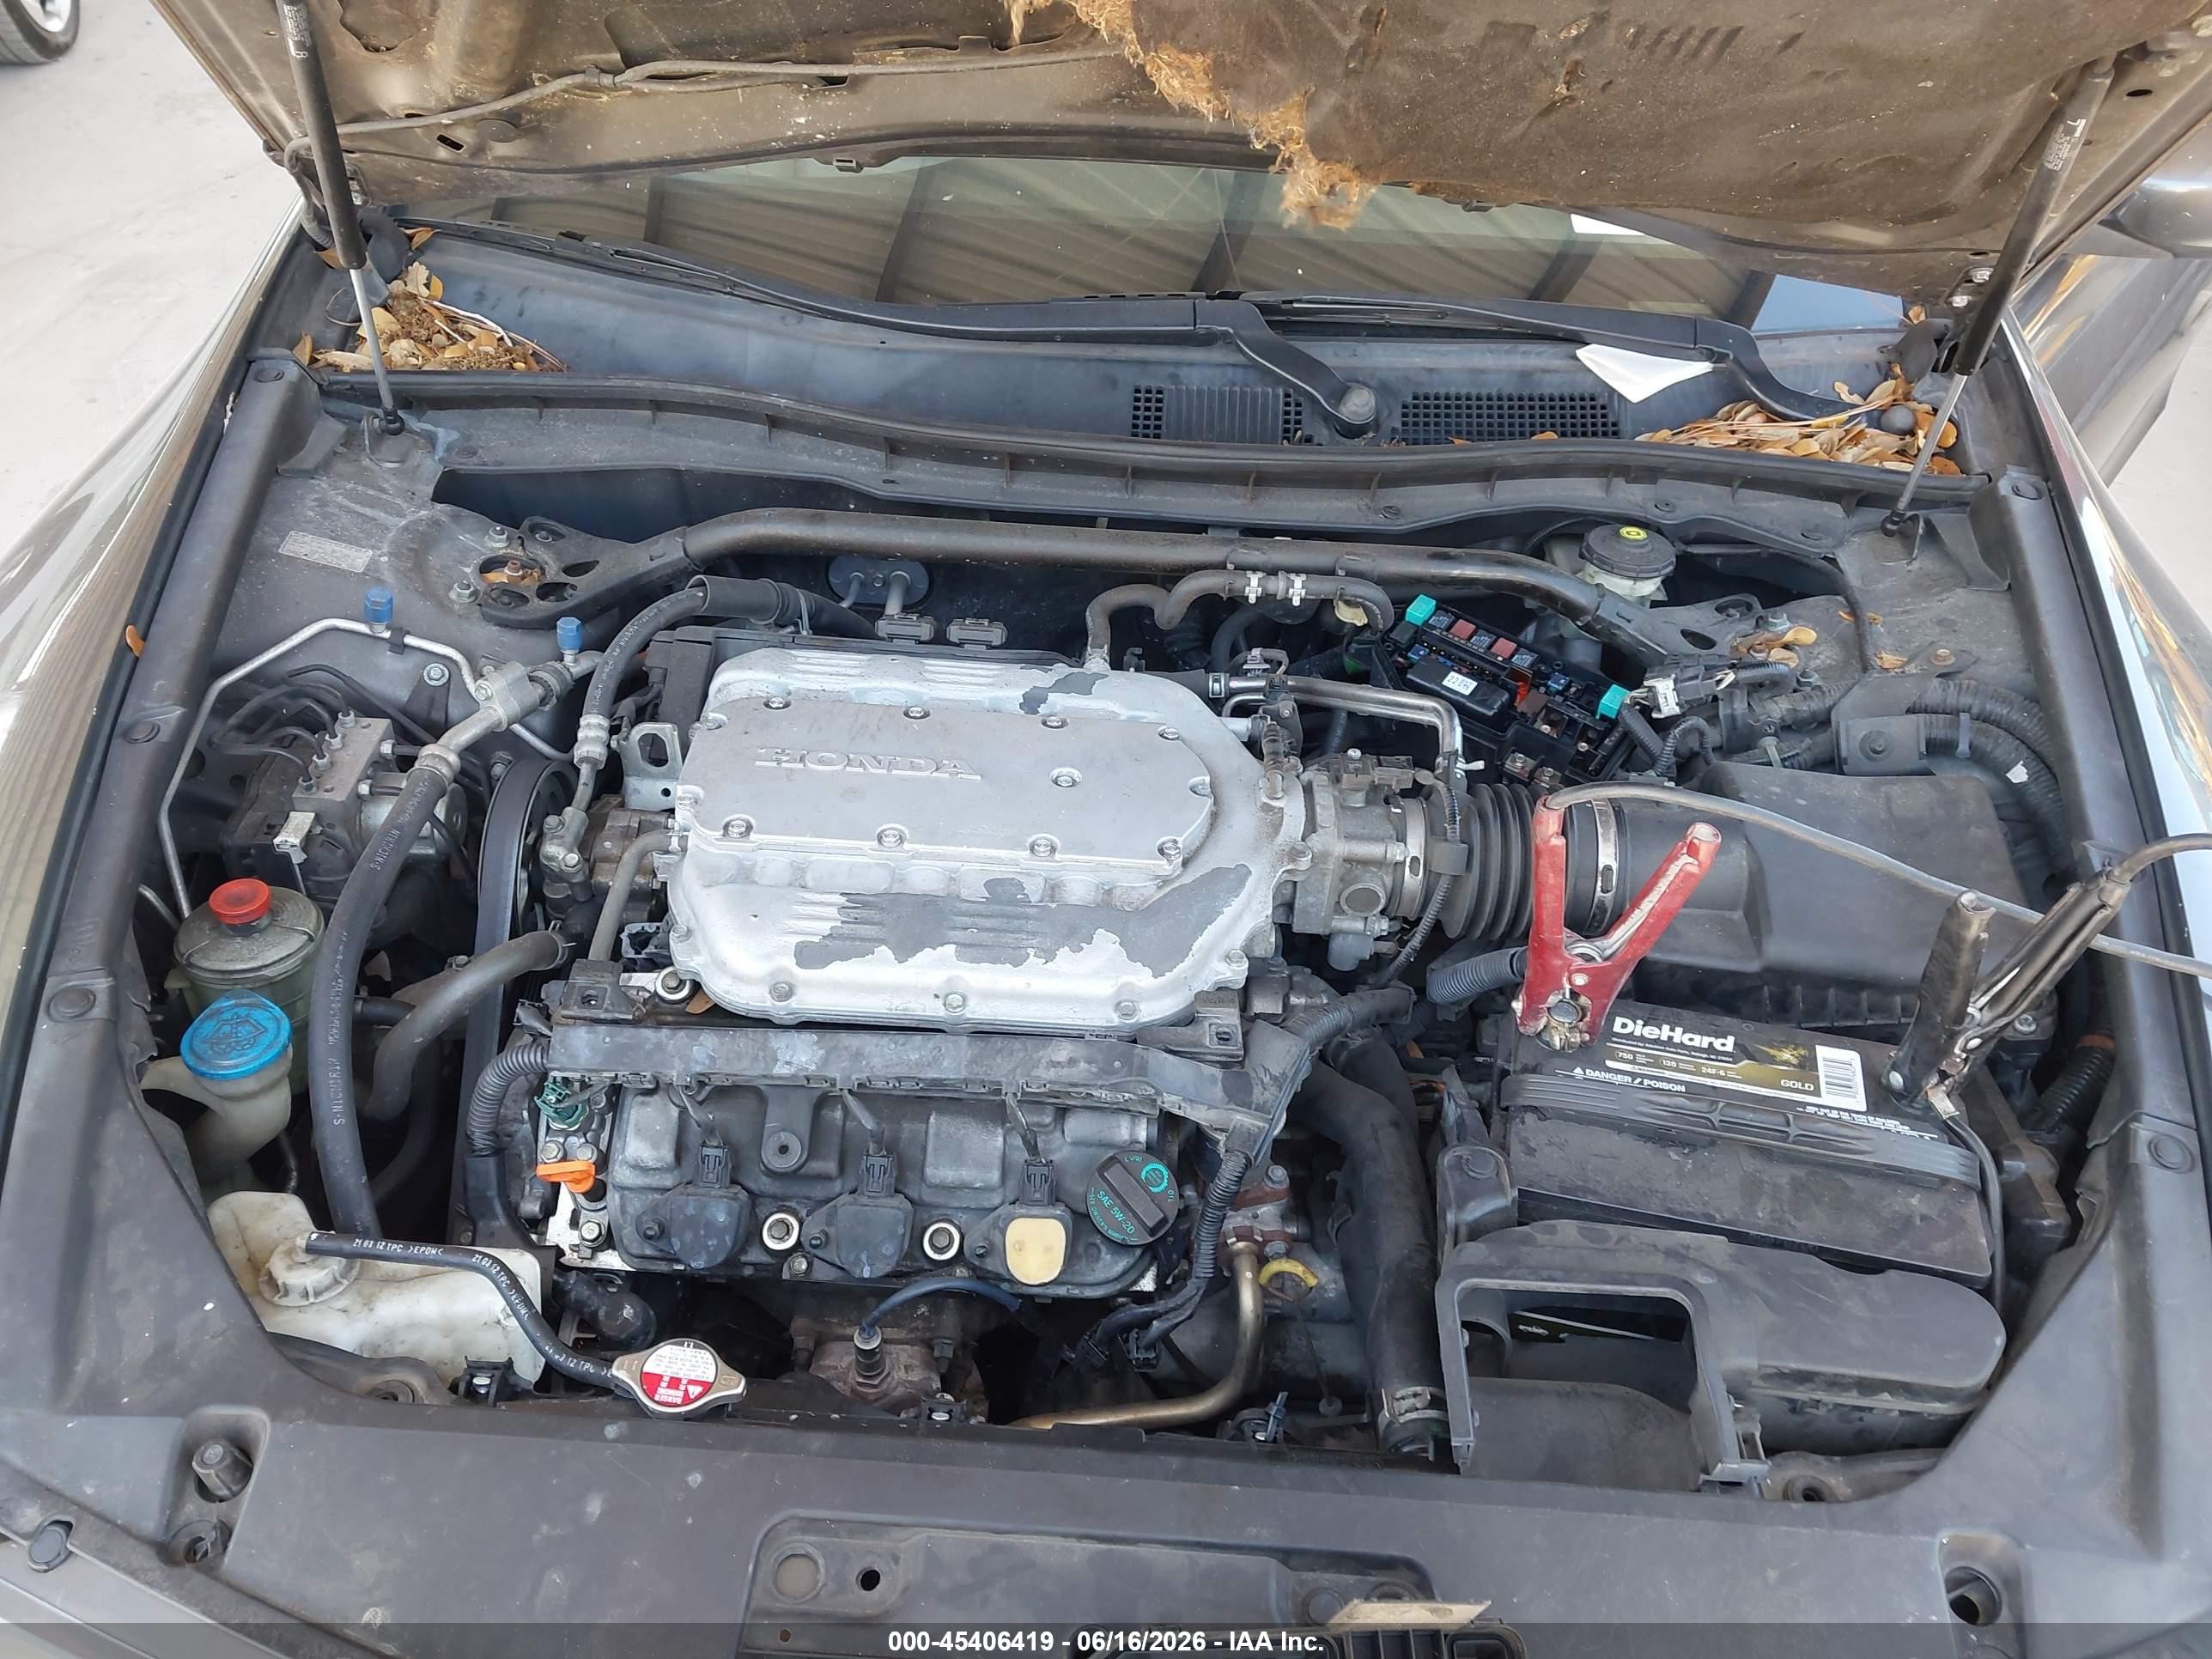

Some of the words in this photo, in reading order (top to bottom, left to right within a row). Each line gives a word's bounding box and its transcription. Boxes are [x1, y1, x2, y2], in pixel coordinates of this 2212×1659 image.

[755, 746, 982, 780] HONDA
[1612, 1016, 1735, 1052] DieHard
[1618, 1052, 1634, 1060] 750
[1662, 1059, 1677, 1068] 130
[1701, 1066, 1726, 1077] 24F-6
[1585, 1068, 1632, 1084] DANGER
[1643, 1079, 1686, 1093] POISON
[1780, 1079, 1814, 1091] GOLD
[1097, 1190, 1114, 1208] SAE
[1110, 1206, 1135, 1235] 5W-20
[375, 1241, 386, 1250] 12
[386, 1243, 404, 1253] TPC
[496, 1271, 511, 1287] TPC
